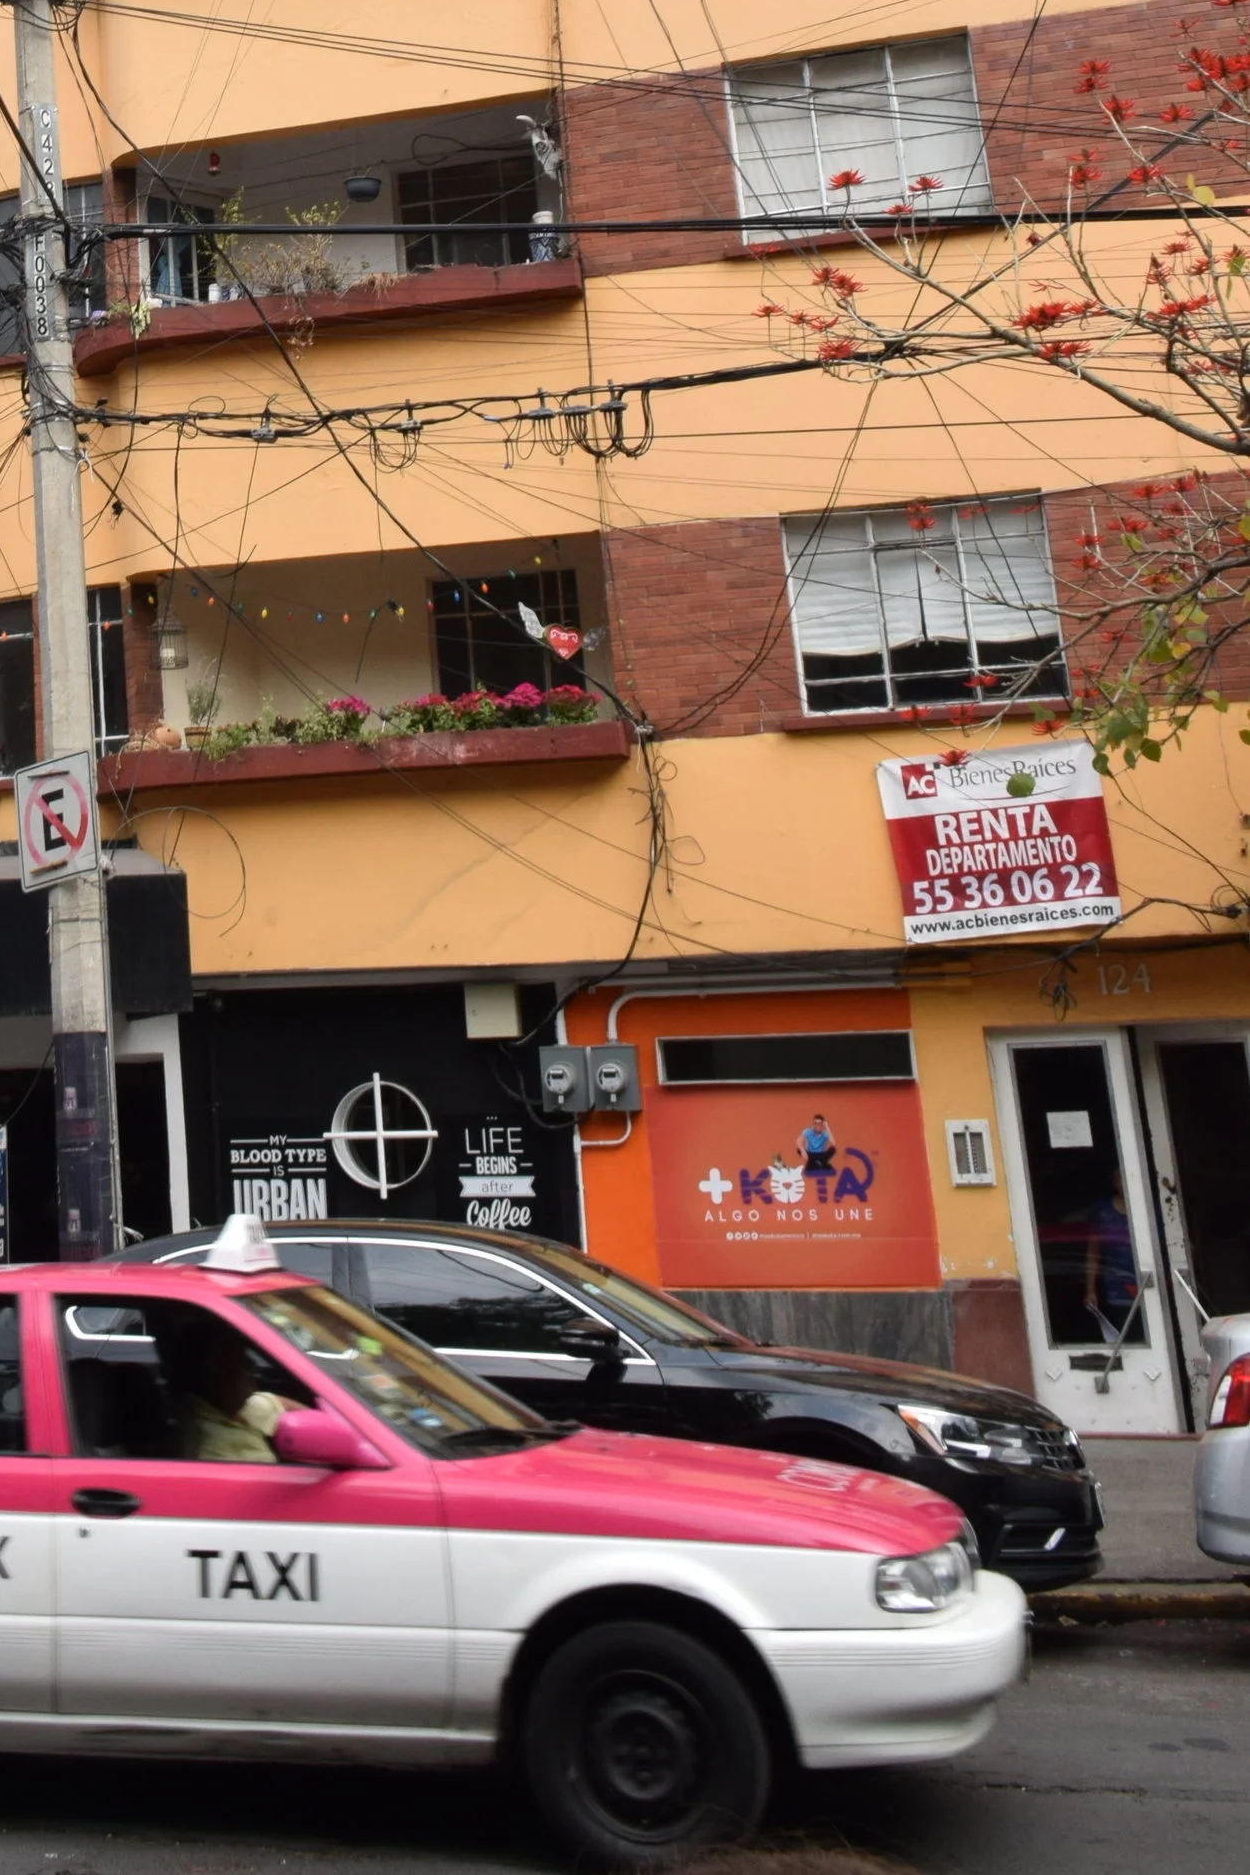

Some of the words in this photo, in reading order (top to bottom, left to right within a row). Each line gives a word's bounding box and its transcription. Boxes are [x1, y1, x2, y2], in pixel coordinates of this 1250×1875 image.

[907, 775, 936, 797] AC
[42, 789, 67, 852] E
[934, 804, 1058, 846] RENTA
[926, 834, 1077, 876] DEPARTAMENTO
[913, 879, 954, 914] 55
[961, 873, 1004, 909] 36
[1010, 868, 1054, 903] 06
[1060, 862, 1103, 898] 22
[911, 903, 1114, 935] www.acbienesraices.com
[269, 1135, 287, 1145] MY
[465, 1127, 524, 1154] LIFE
[230, 1149, 282, 1164] BLOOD
[285, 1148, 327, 1163] TYPE
[475, 1156, 518, 1175] BEGINS
[273, 1165, 285, 1177] IS
[233, 1178, 328, 1221] URBAN
[481, 1180, 513, 1193] after
[466, 1198, 532, 1230] Coffee
[704, 1210, 760, 1222] ALGO
[777, 1209, 819, 1222] NOS
[835, 1208, 873, 1221] UNE
[186, 1550, 320, 1602] TAXI
